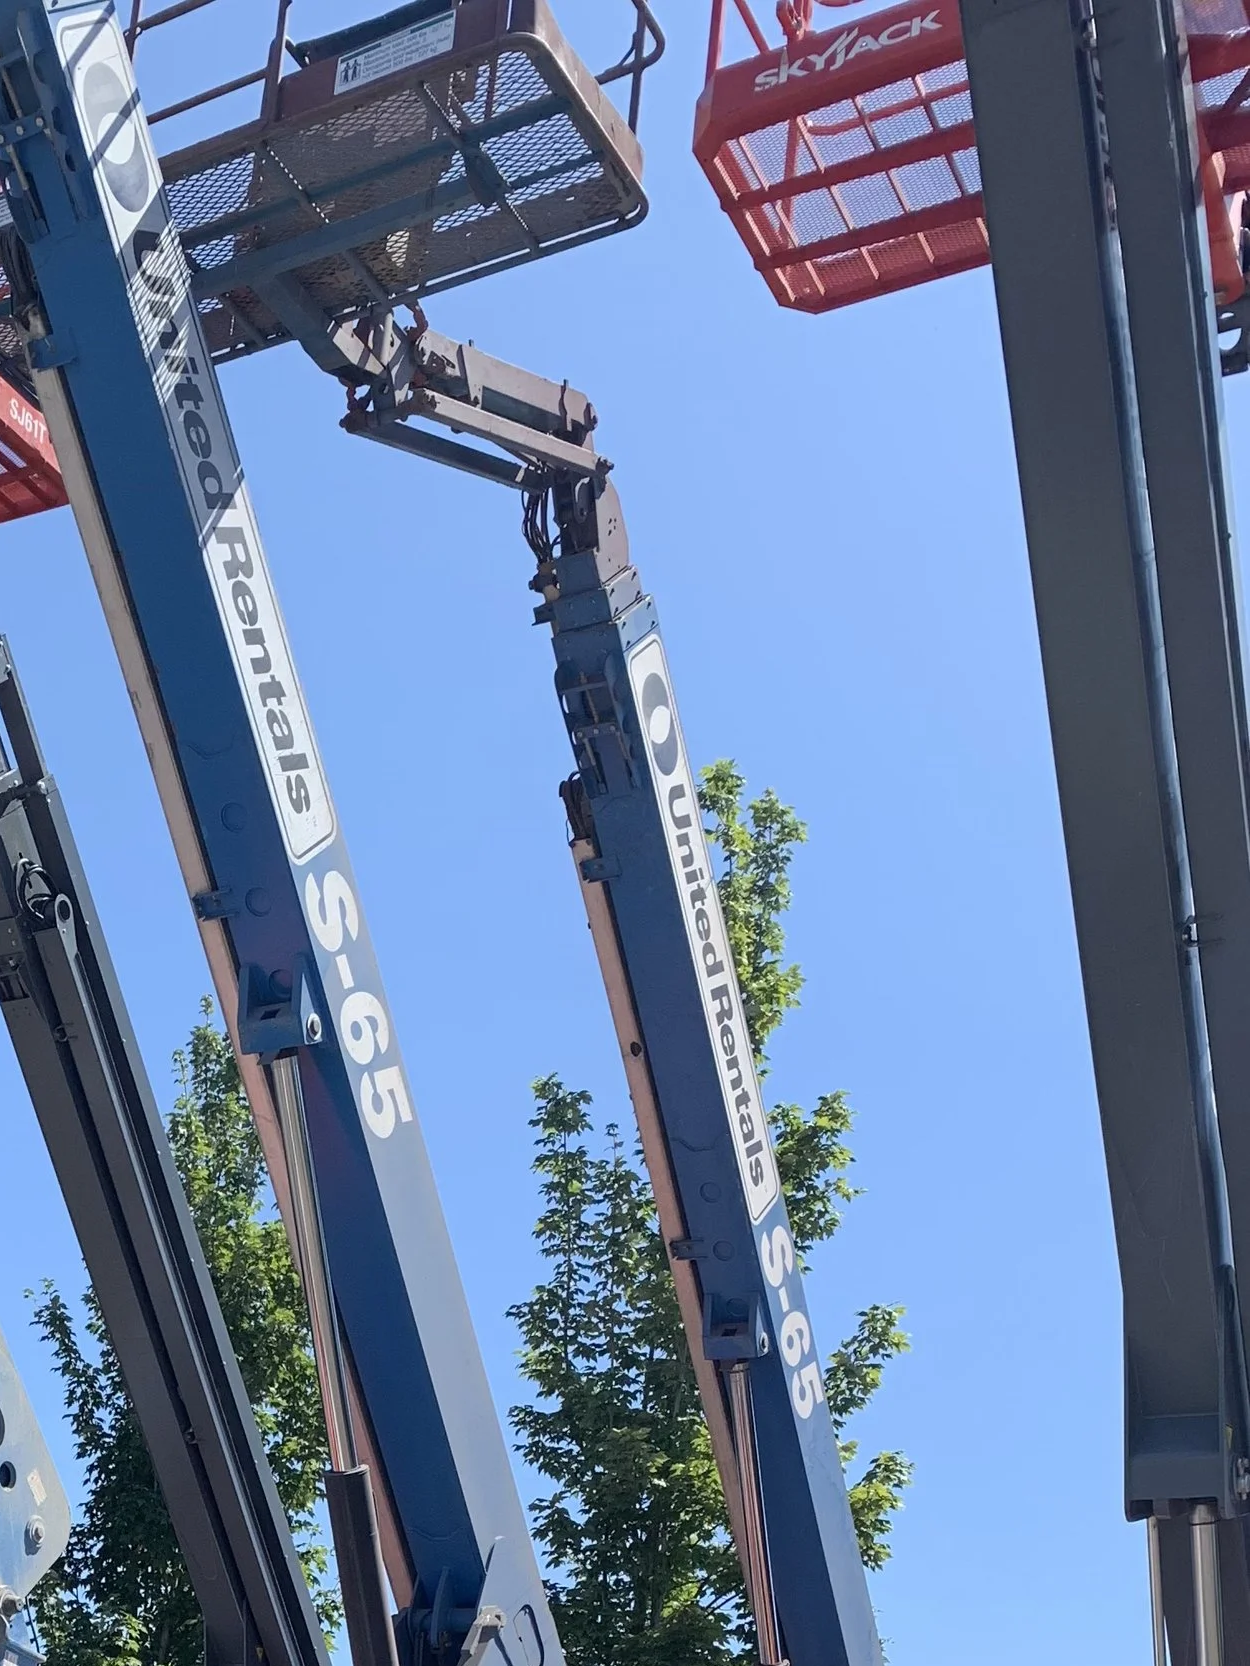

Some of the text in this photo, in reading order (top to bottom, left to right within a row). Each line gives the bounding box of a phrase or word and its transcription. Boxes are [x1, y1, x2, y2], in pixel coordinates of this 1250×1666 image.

[754, 11, 943, 91] SKYJACK
[133, 228, 311, 815] United Rentals
[305, 869, 413, 1139] S-65
[668, 784, 766, 1190] United Rentals
[761, 1226, 824, 1420] S-65
